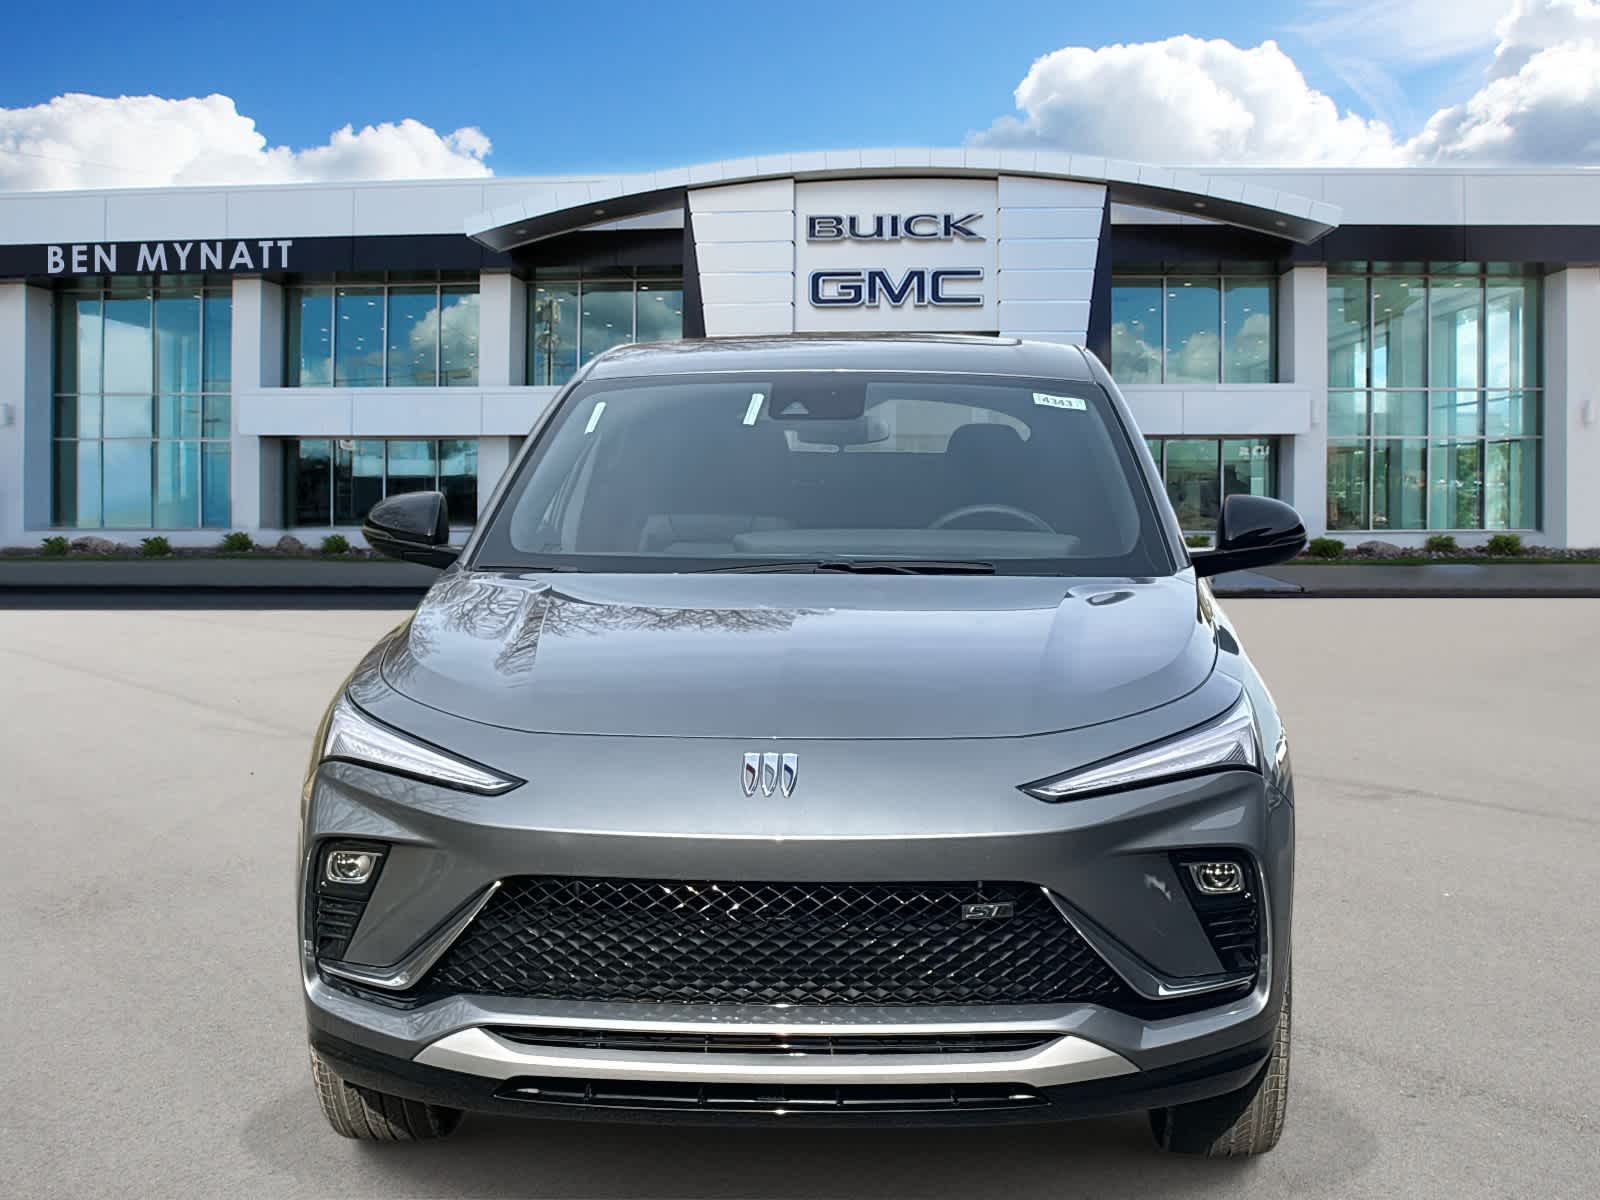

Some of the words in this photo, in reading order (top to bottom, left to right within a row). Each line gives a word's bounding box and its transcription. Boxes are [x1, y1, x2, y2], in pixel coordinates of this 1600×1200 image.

[807, 214, 984, 241] BUICK
[47, 245, 117, 273] BEN
[136, 240, 293, 272] MYNATT
[809, 267, 984, 308] GMC
